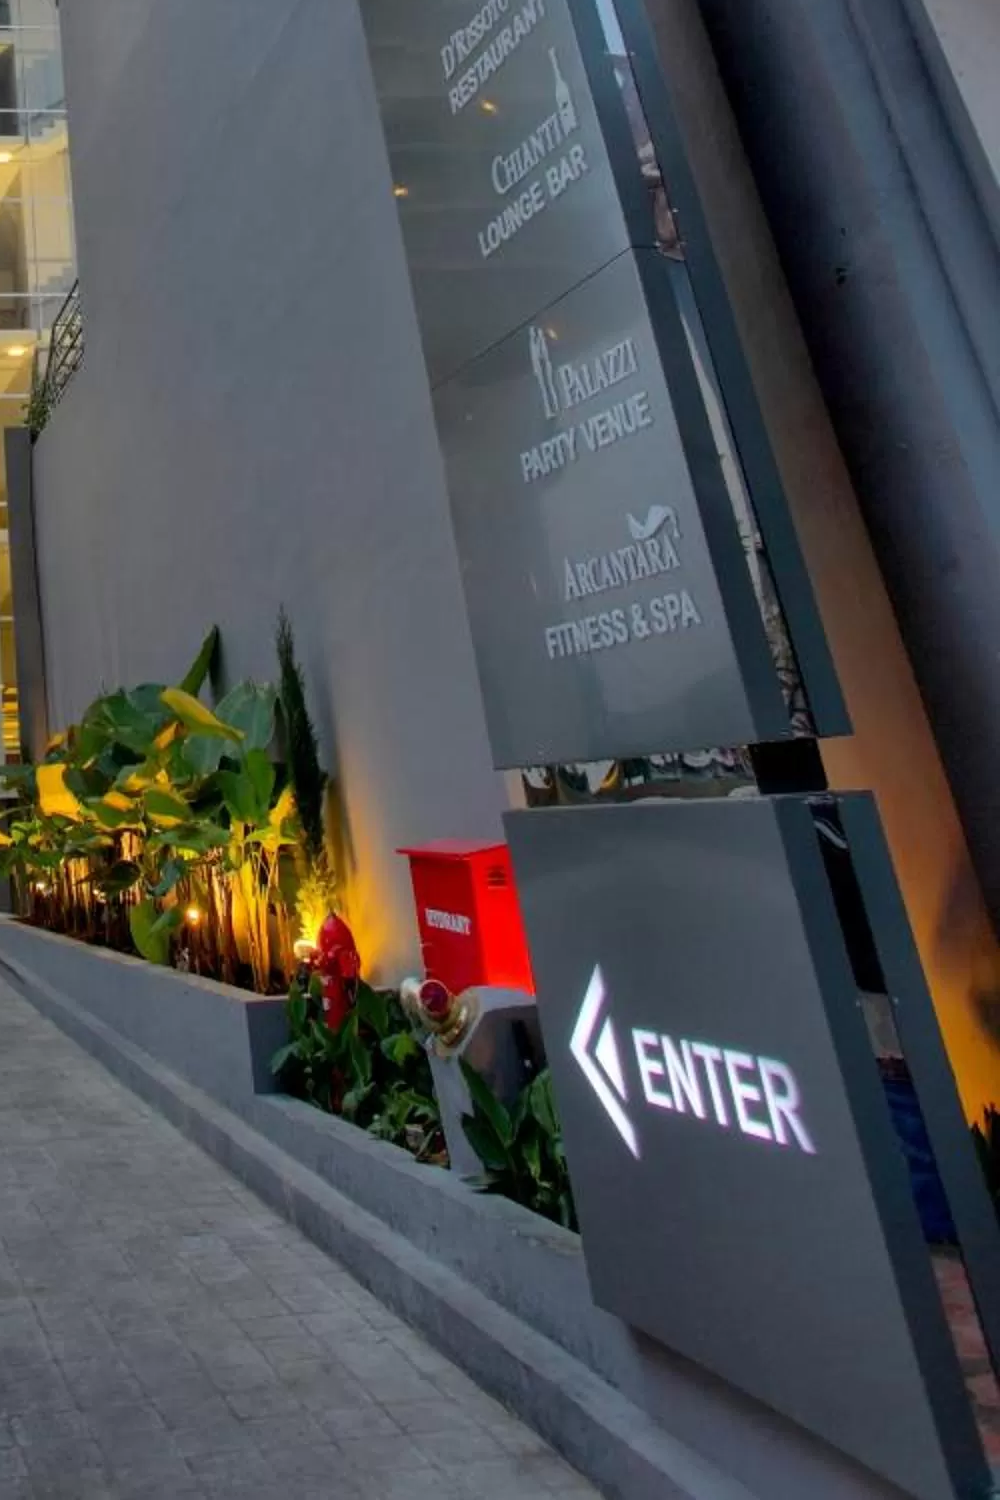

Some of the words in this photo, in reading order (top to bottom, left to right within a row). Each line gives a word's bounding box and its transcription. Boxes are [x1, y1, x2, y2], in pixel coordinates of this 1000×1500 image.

[491, 112, 569, 194] CHIANTI
[477, 181, 546, 257] LOUNGE
[546, 143, 589, 199] BAR
[559, 337, 640, 408] PALAZZI
[520, 427, 580, 483] PARTY
[582, 391, 652, 452] VENUE
[564, 536, 681, 601] ARCANTARA
[545, 607, 628, 659] FITNESS
[631, 602, 651, 639] &
[650, 588, 701, 634] SPA
[631, 1027, 818, 1155] ENTER
